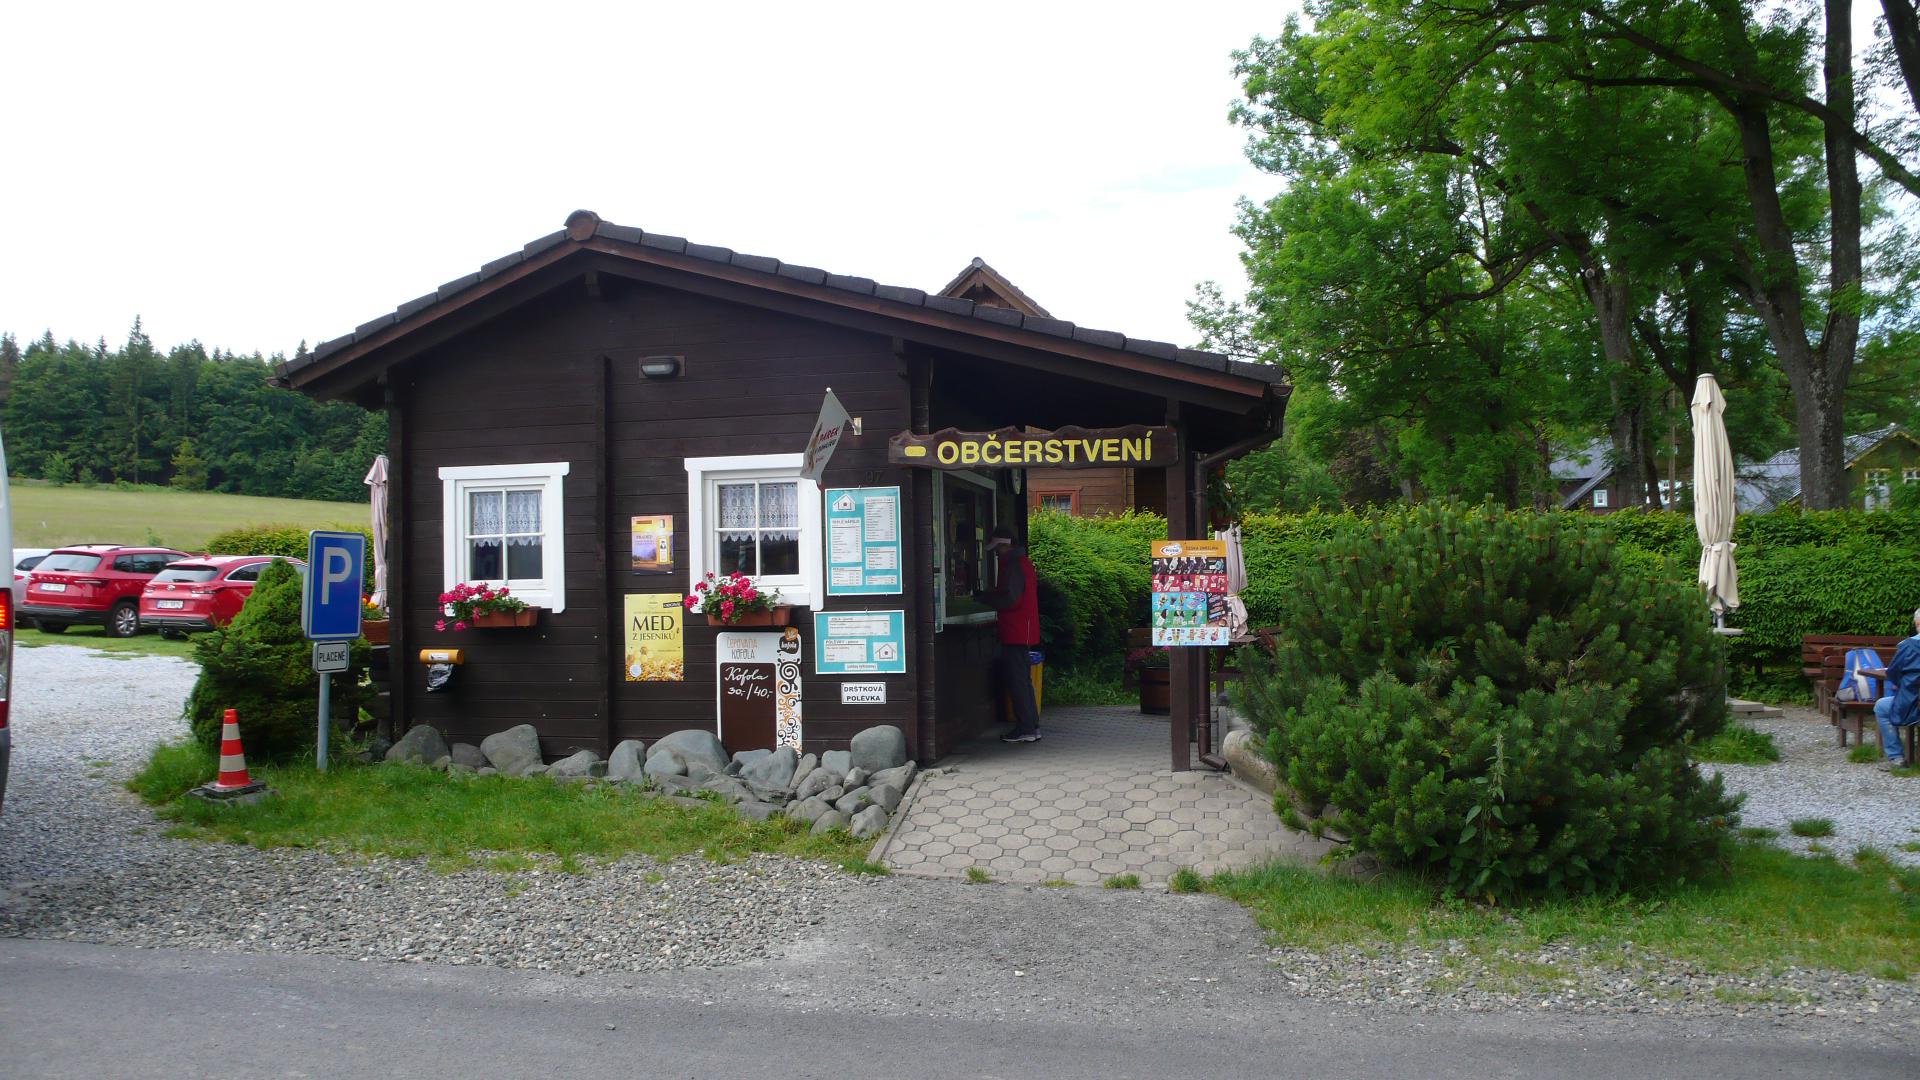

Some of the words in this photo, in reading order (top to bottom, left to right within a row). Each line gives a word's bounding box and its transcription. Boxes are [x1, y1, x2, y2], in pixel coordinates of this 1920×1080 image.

[937, 430, 1153, 464] OBČERSTVENÍ
[322, 547, 352, 605] P
[633, 615, 675, 631] MED
[320, 650, 346, 662] PLACENÉ
[731, 649, 756, 660] KOFOLA
[724, 666, 769, 687] Kofola
